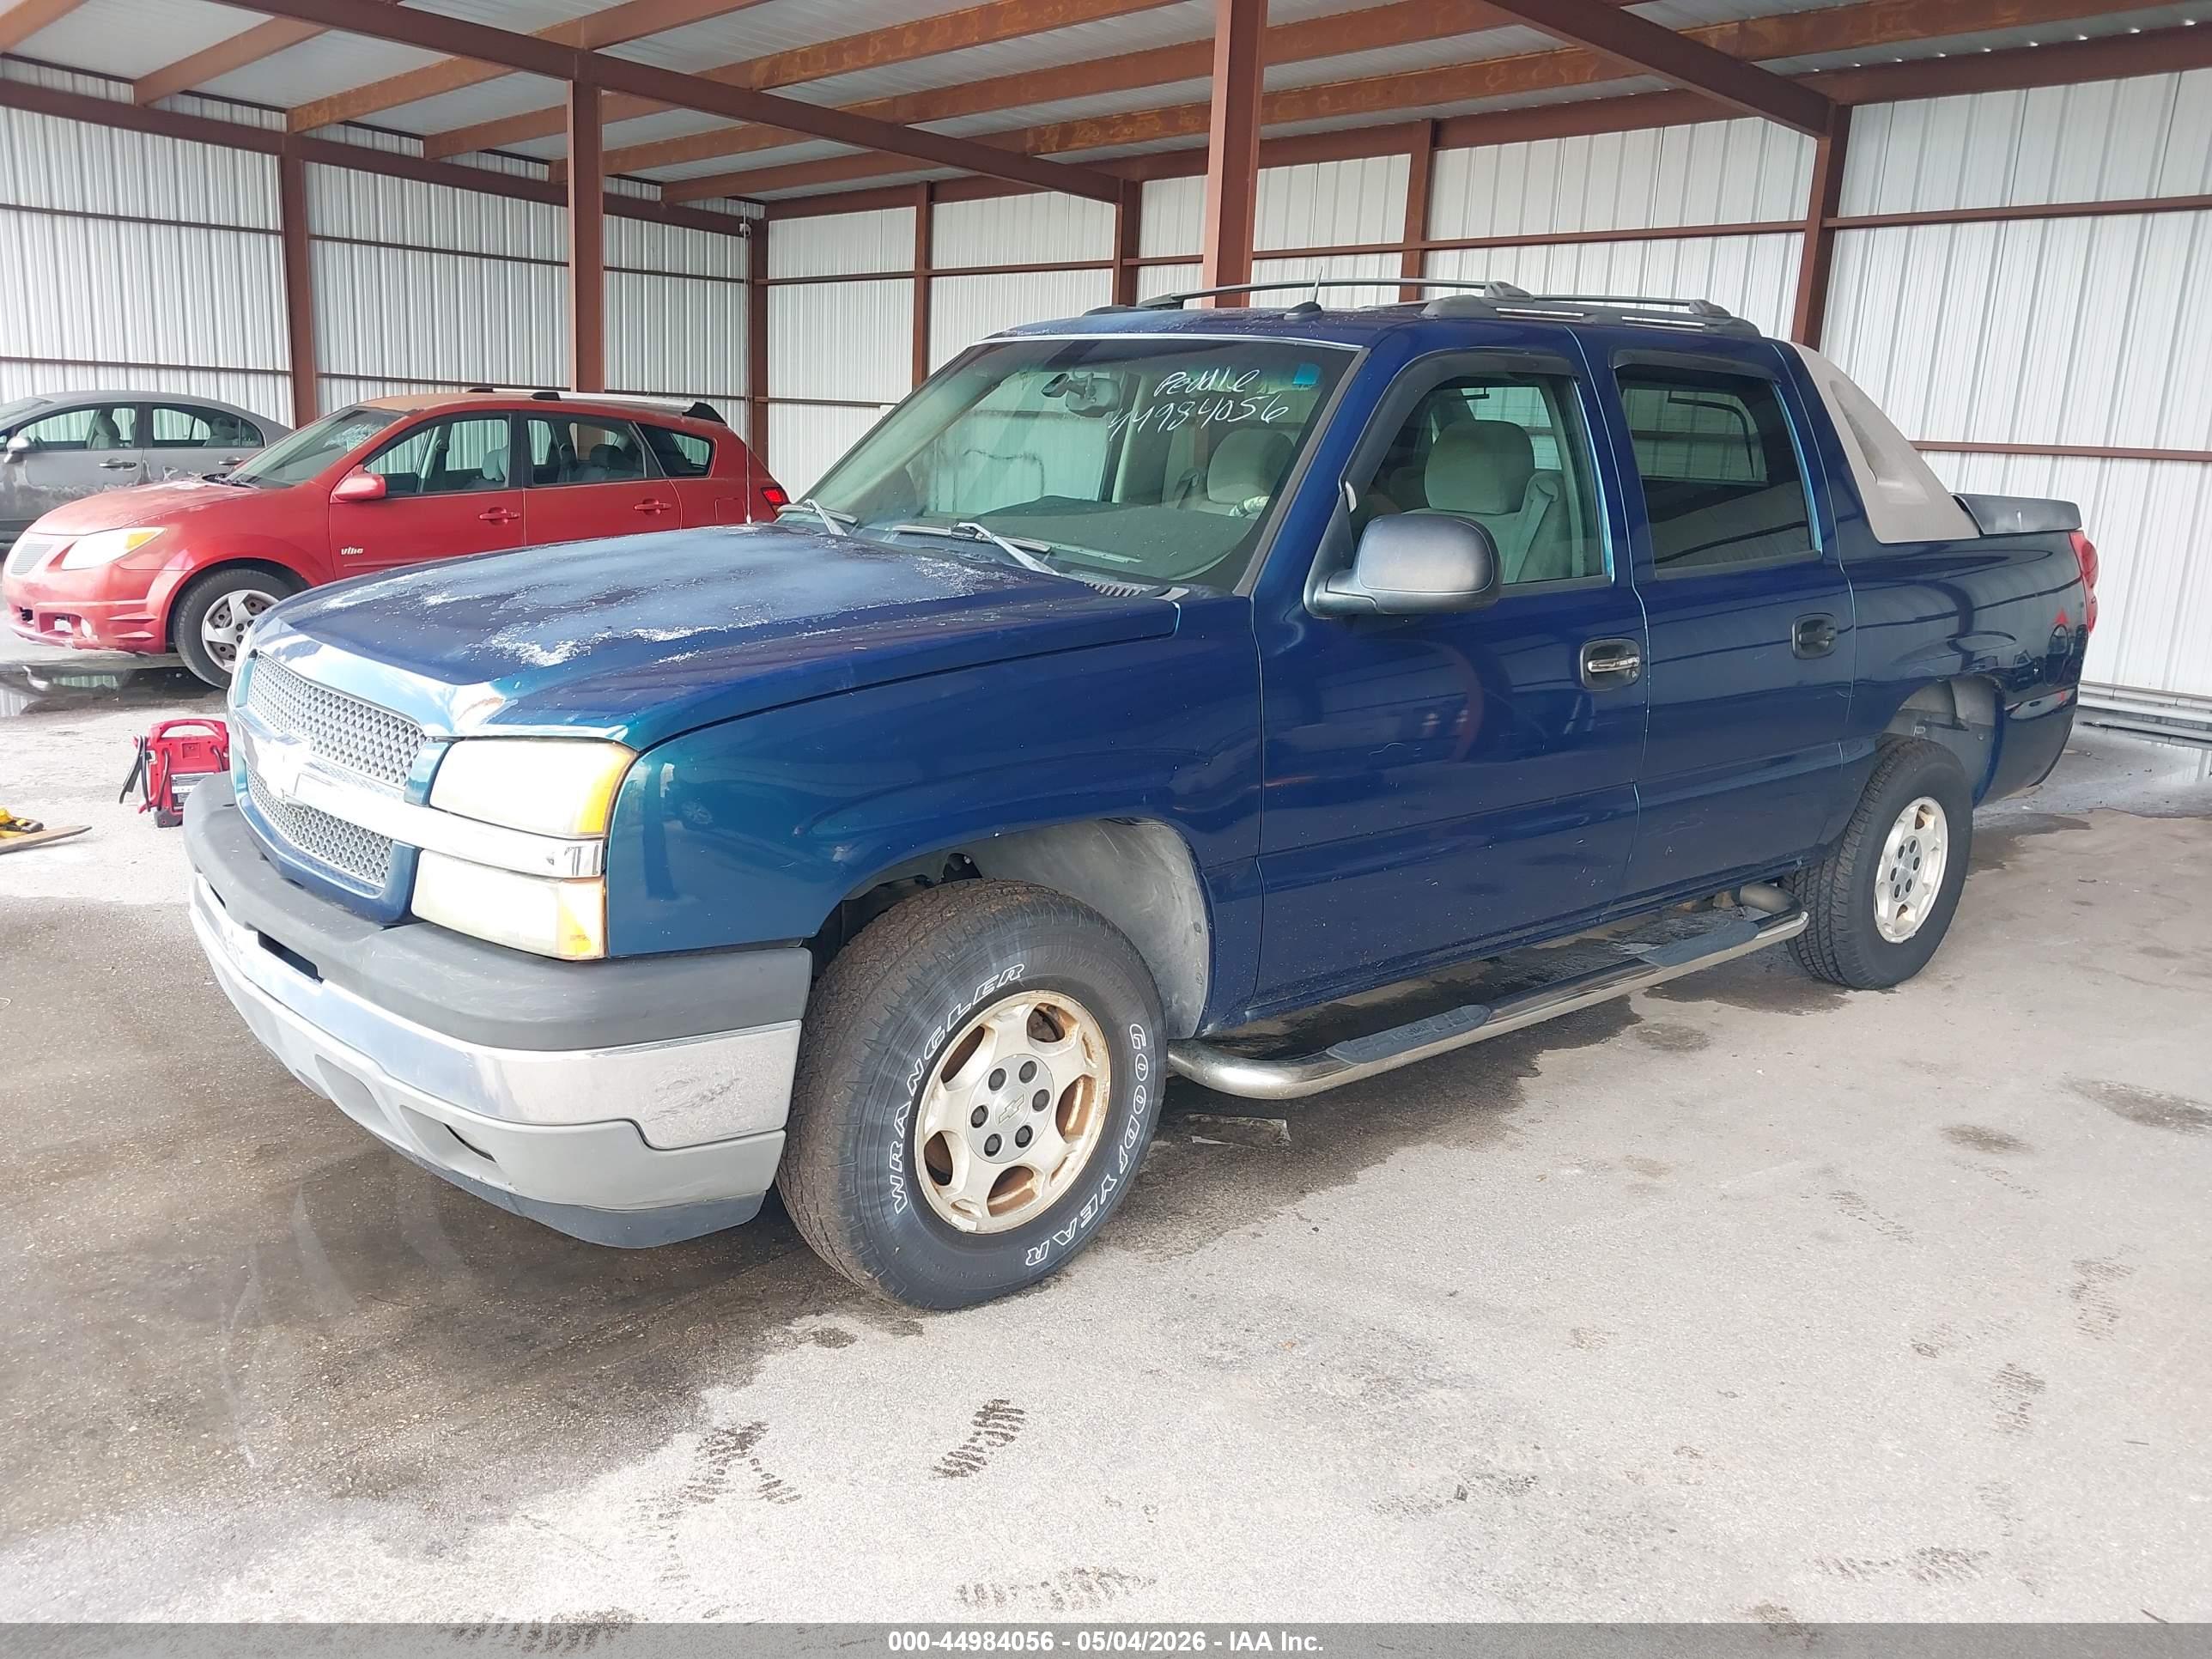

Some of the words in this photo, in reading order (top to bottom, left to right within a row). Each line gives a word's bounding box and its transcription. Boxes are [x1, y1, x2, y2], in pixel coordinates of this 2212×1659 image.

[1108, 393, 1290, 441] 44984056
[886, 963, 1025, 1214] WRANGLER
[1025, 1023, 1149, 1267] GOODYEAR
